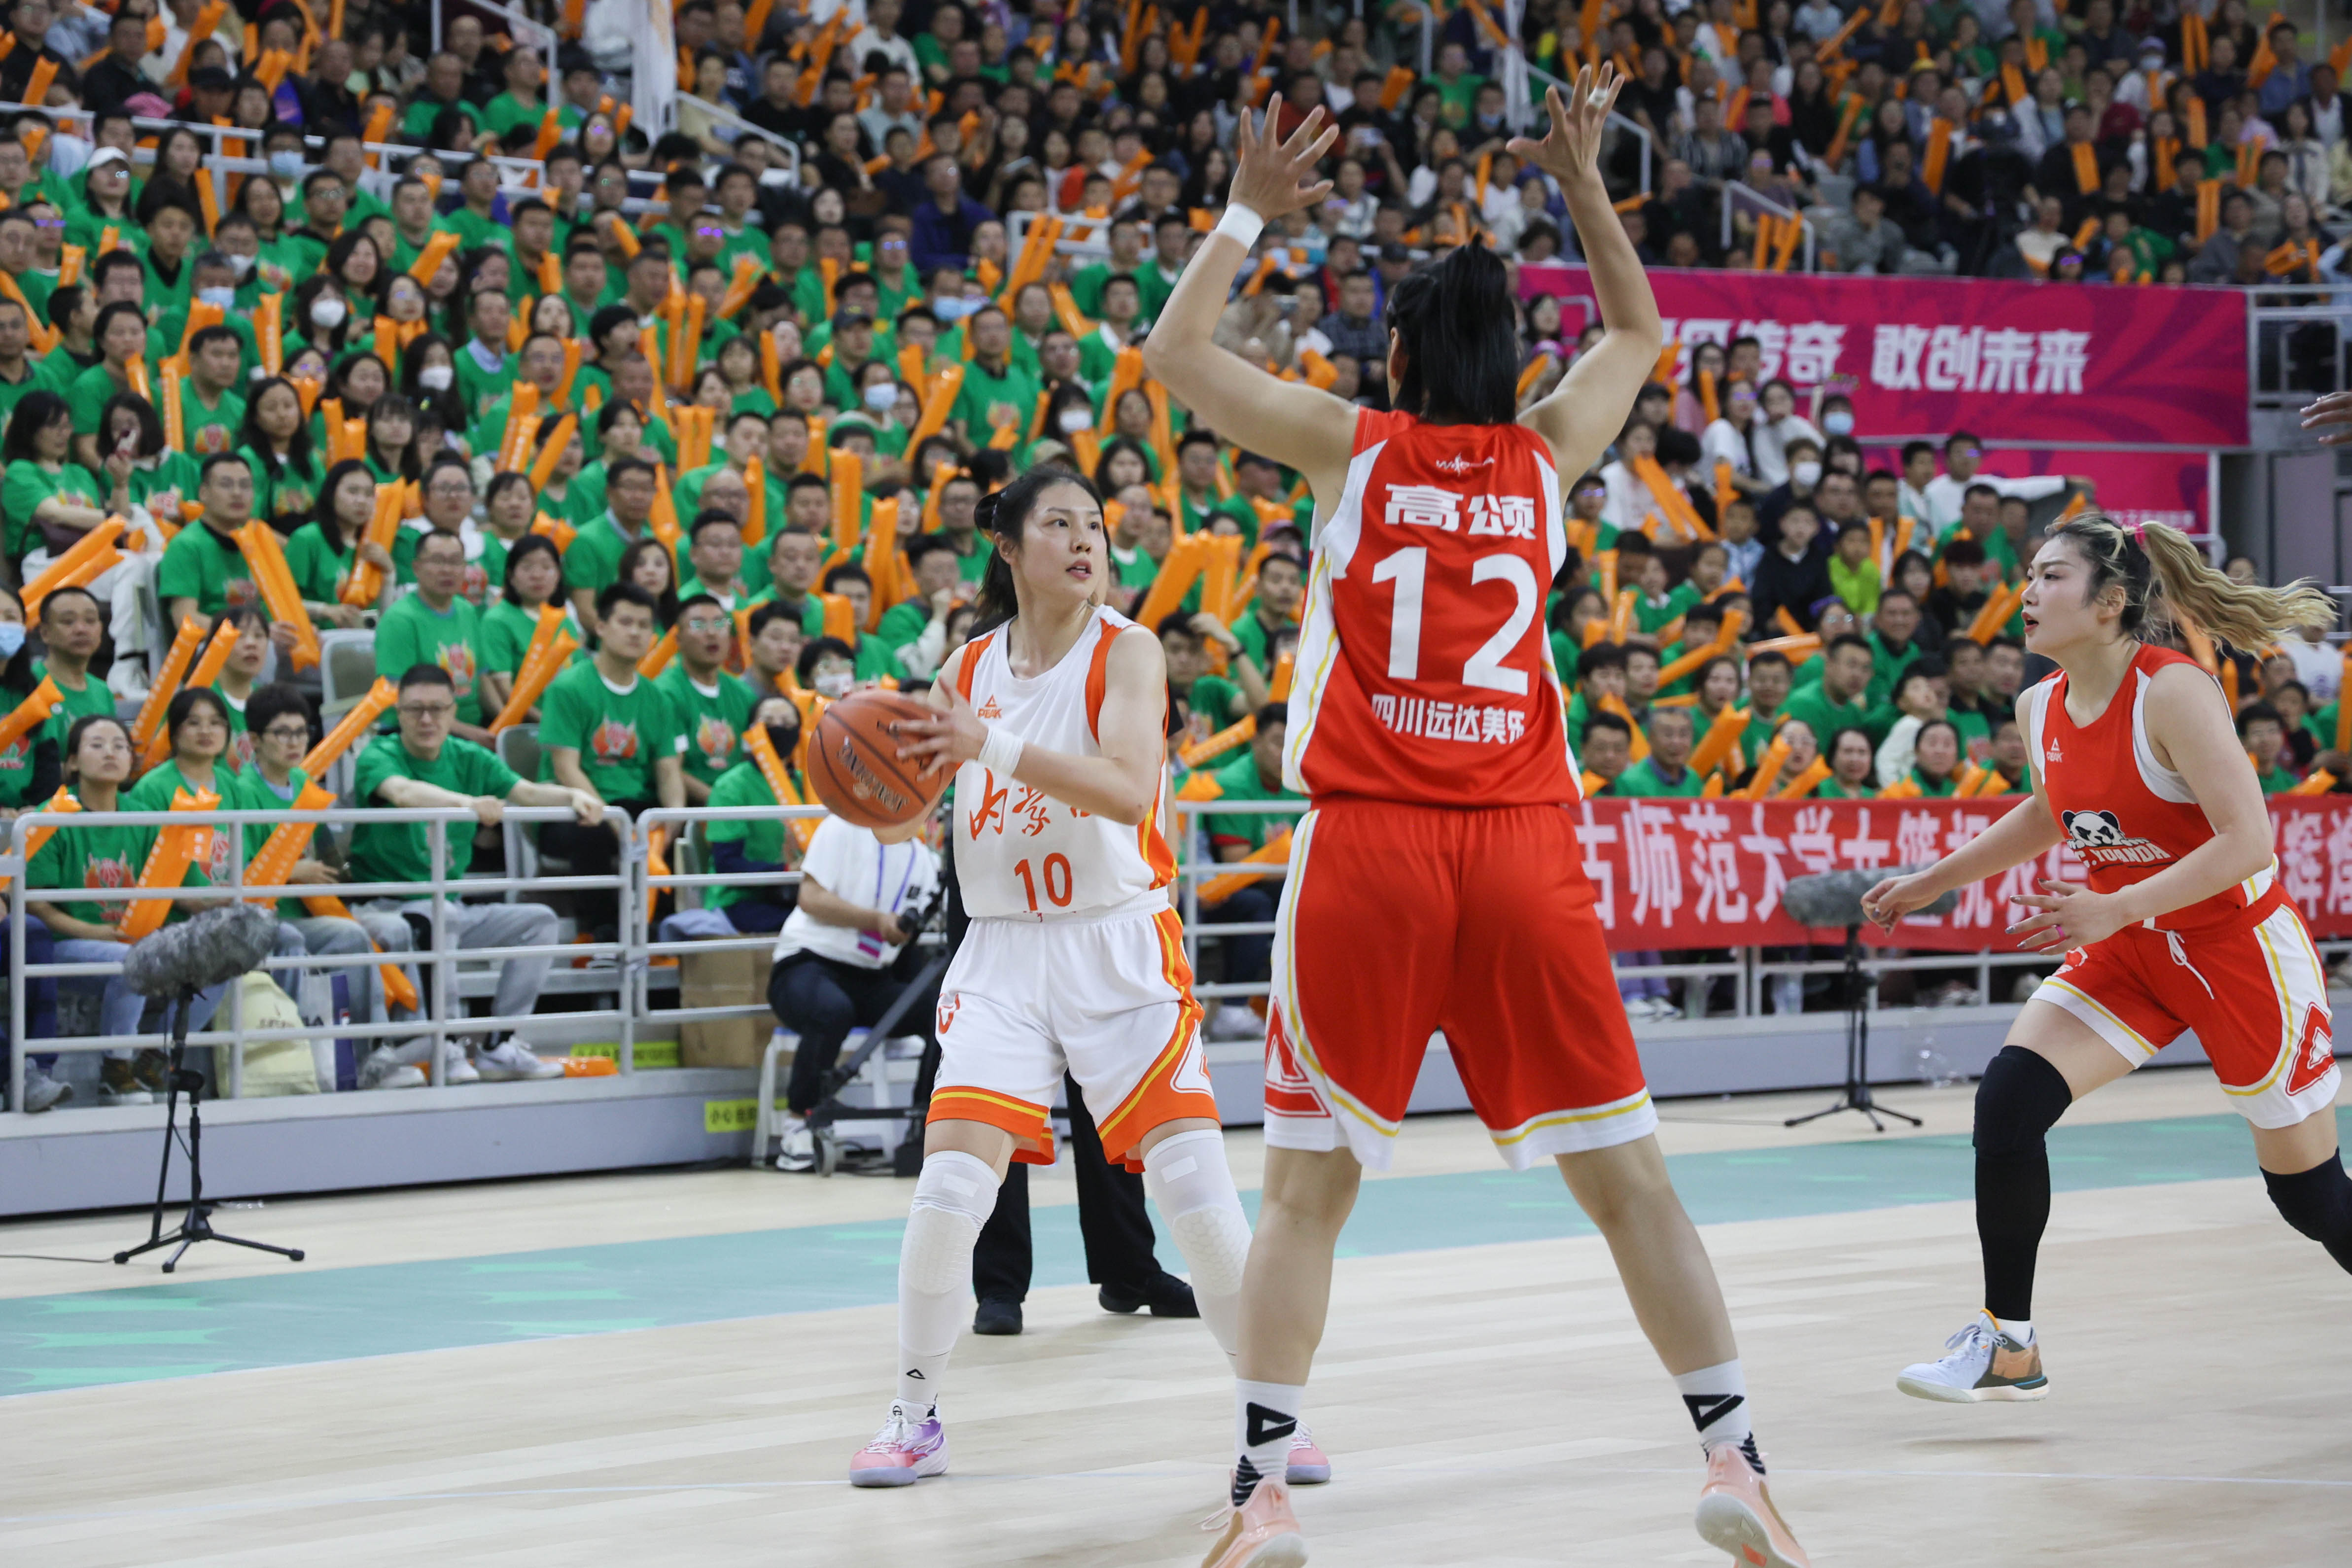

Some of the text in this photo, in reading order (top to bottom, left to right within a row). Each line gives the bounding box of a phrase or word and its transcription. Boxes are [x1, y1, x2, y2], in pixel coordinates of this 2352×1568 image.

[1871, 324, 2091, 394] 敢创未来
[1385, 483, 1536, 540] 高颂
[1372, 547, 1538, 696] 12
[978, 708, 1002, 718] PEAK
[1372, 694, 1525, 744] 四川远达美乐
[970, 767, 1090, 841] 内蒙
[1014, 852, 1072, 911] 10
